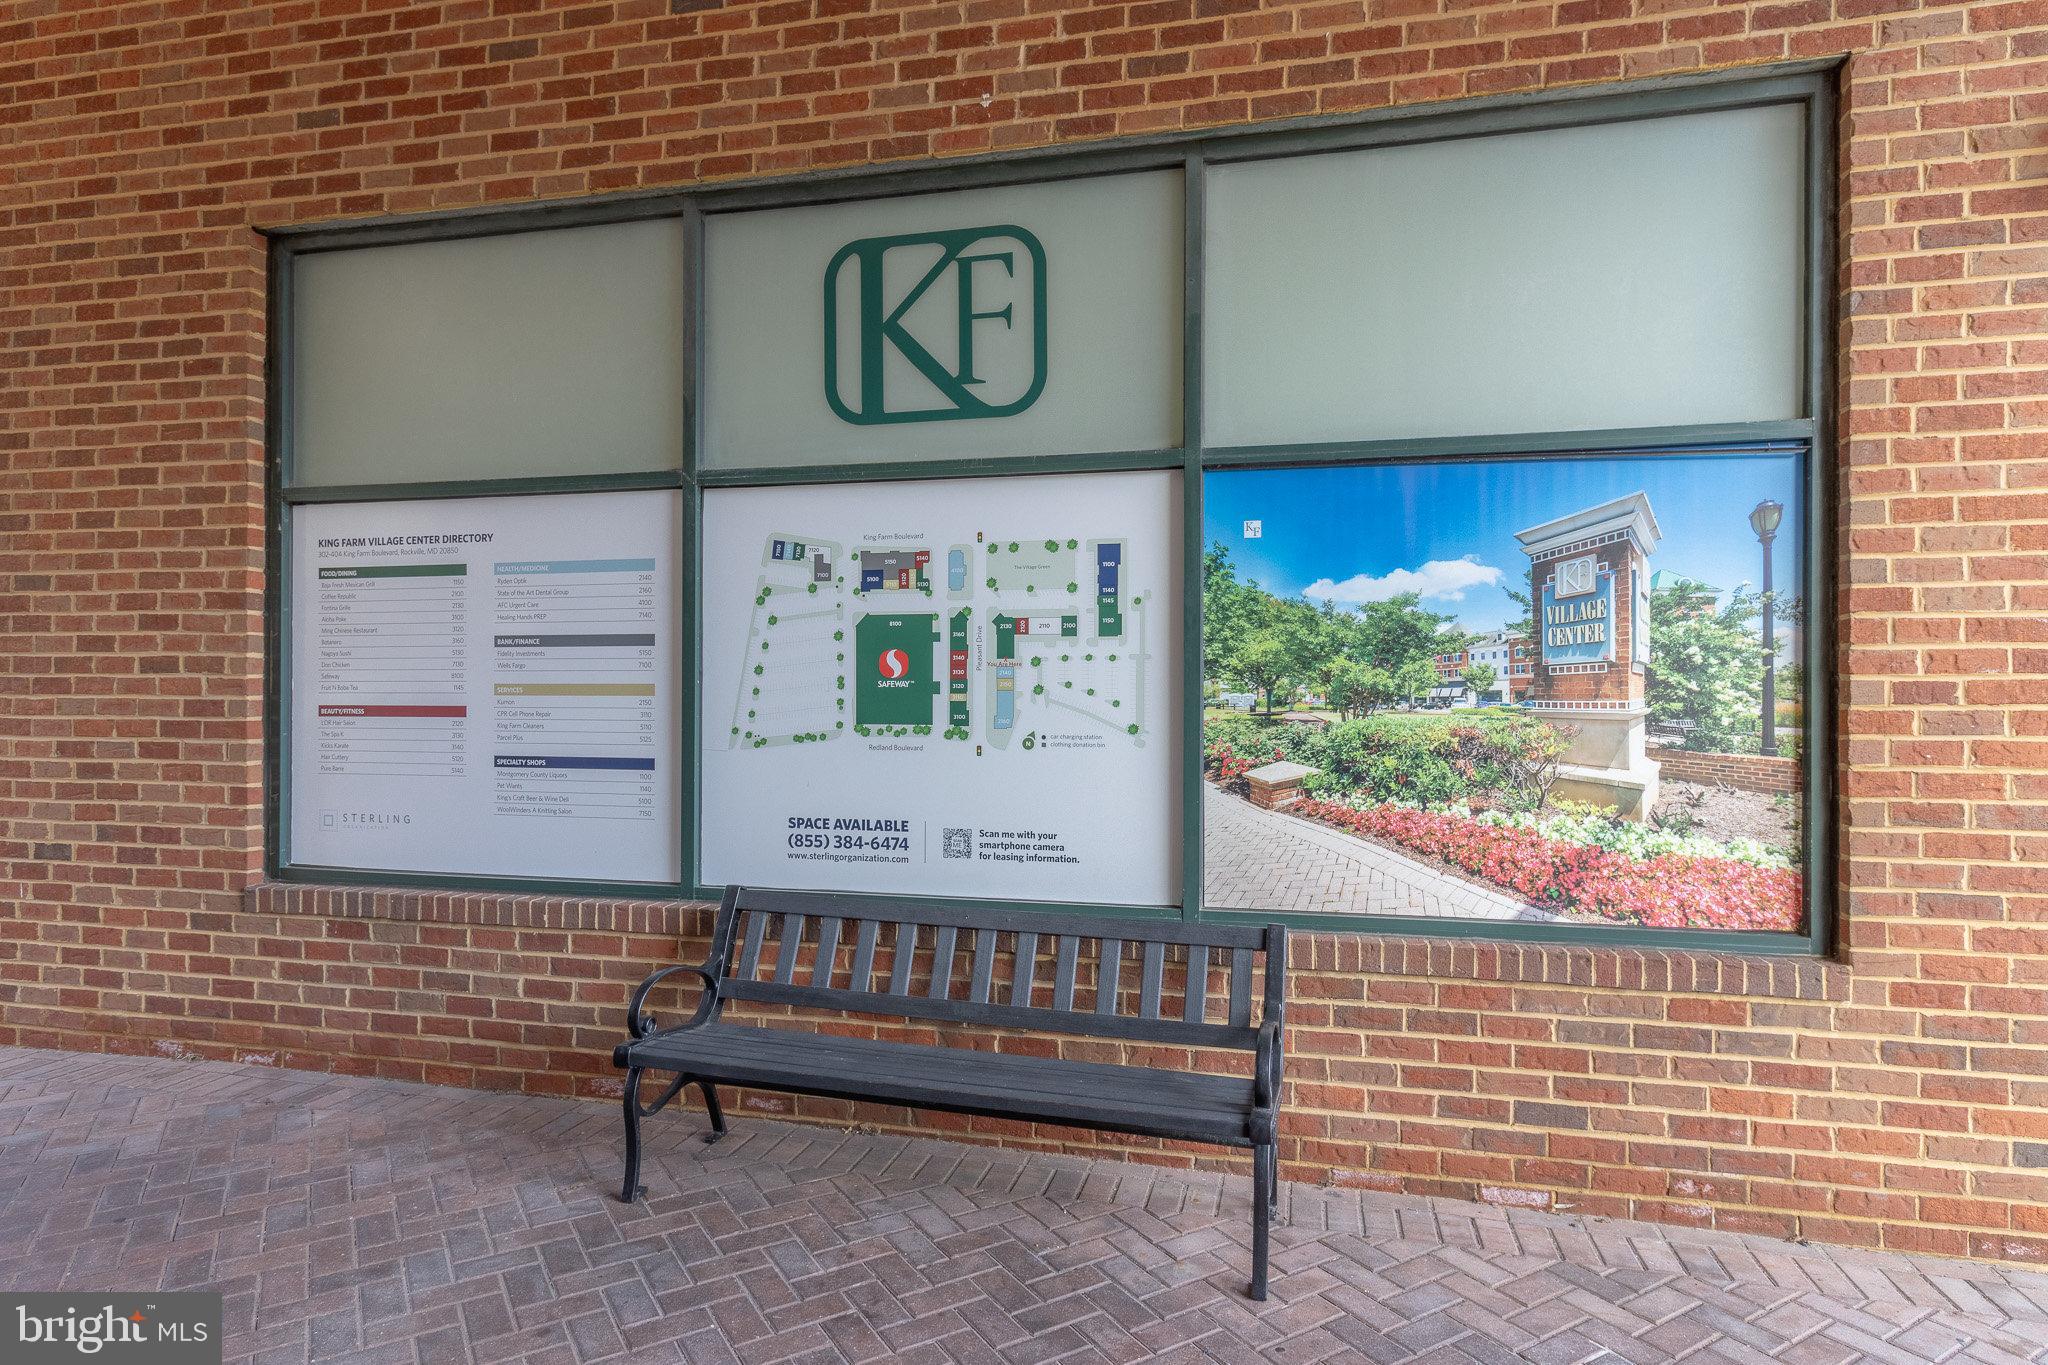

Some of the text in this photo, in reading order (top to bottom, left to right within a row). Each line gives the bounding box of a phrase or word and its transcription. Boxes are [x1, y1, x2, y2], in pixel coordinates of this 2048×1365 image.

[318, 533, 494, 547] KING FARM VILLAGE CENTER DIRECTORY
[343, 550, 355, 558] King
[371, 548, 399, 556] Boulevard,
[1547, 598, 1607, 625] VILLAGE
[1548, 623, 1605, 647] CENTER
[878, 680, 910, 688] SAFEWAY
[343, 813, 411, 824] STERLING
[788, 817, 909, 832] SPACE AVAILABLE
[979, 830, 1057, 841] Scan me with your
[788, 834, 909, 850] (855) 384-6474
[979, 841, 1064, 852] smartphone camera
[788, 851, 909, 863] www.sterlingorganization.com
[979, 852, 1080, 864] for leasing information.
